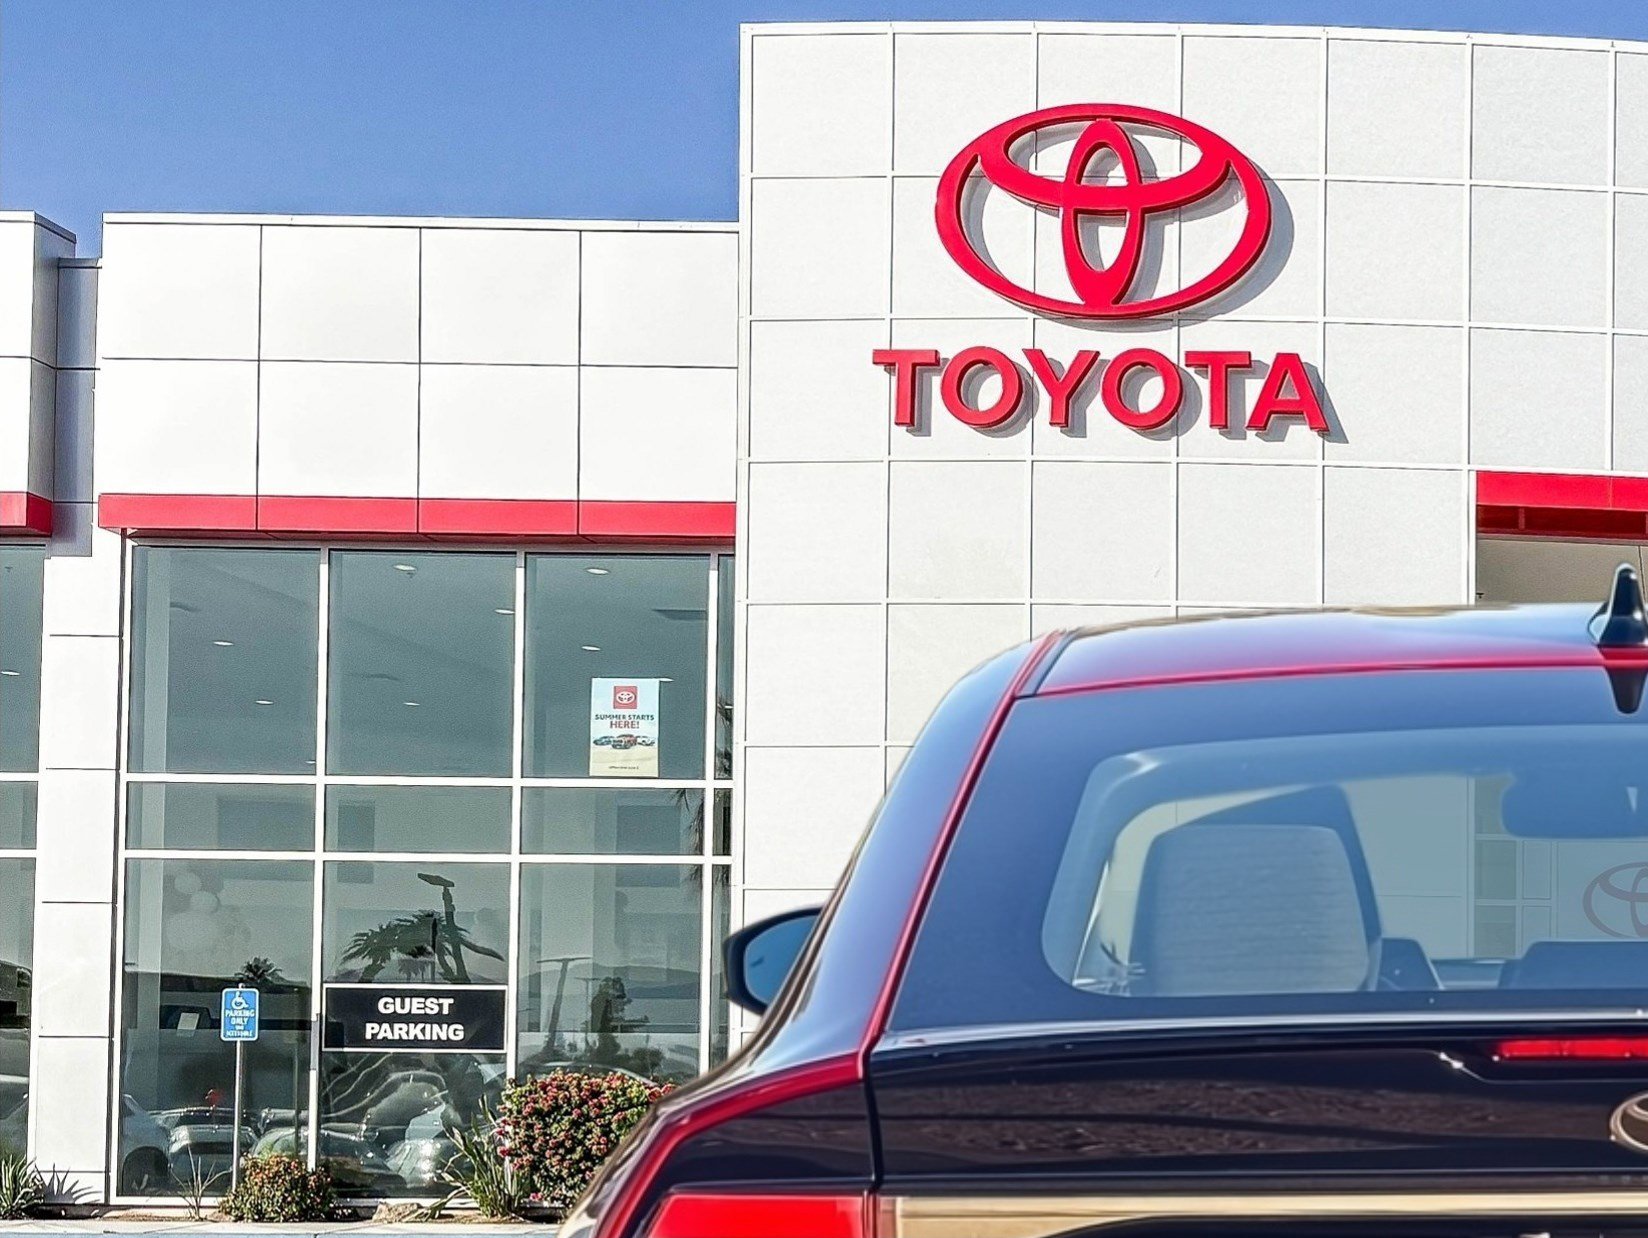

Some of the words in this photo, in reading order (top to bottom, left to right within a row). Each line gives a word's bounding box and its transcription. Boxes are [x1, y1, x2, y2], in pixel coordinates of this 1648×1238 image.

[872, 346, 1329, 432] TOYOTA
[610, 720, 640, 729] HERE!
[225, 1009, 255, 1018] PARKING
[378, 997, 454, 1015] GUEST
[365, 1022, 465, 1041] PARKING
